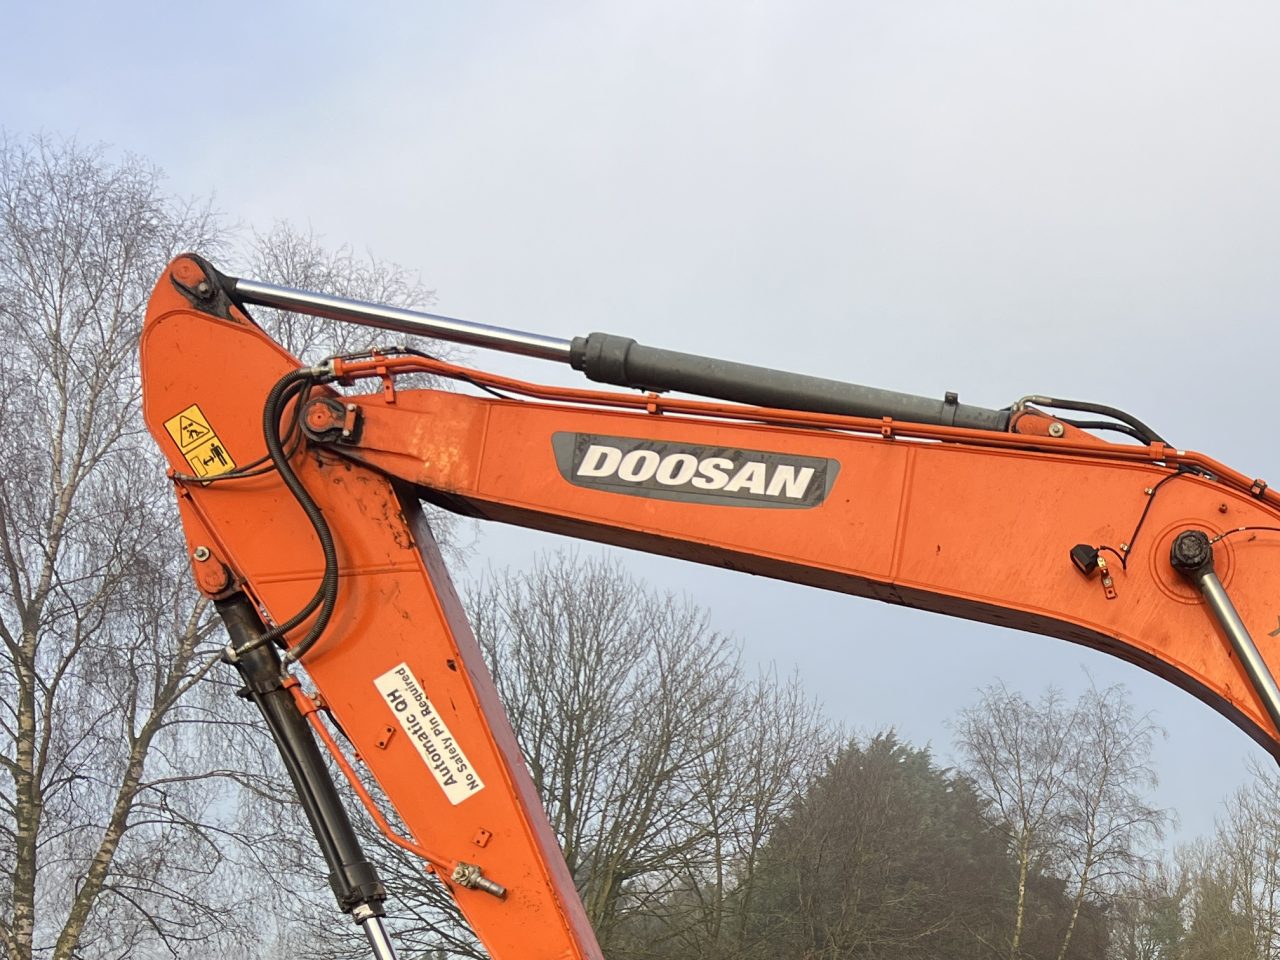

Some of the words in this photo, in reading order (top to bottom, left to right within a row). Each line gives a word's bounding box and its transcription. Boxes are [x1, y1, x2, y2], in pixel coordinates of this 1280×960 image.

[577, 445, 815, 499] DOOSAN
[386, 688, 408, 713] QH
[395, 667, 432, 718] Required
[429, 716, 445, 738] Pin
[406, 713, 458, 787] Automatic
[441, 737, 468, 773] Safety
[465, 773, 479, 791] No
